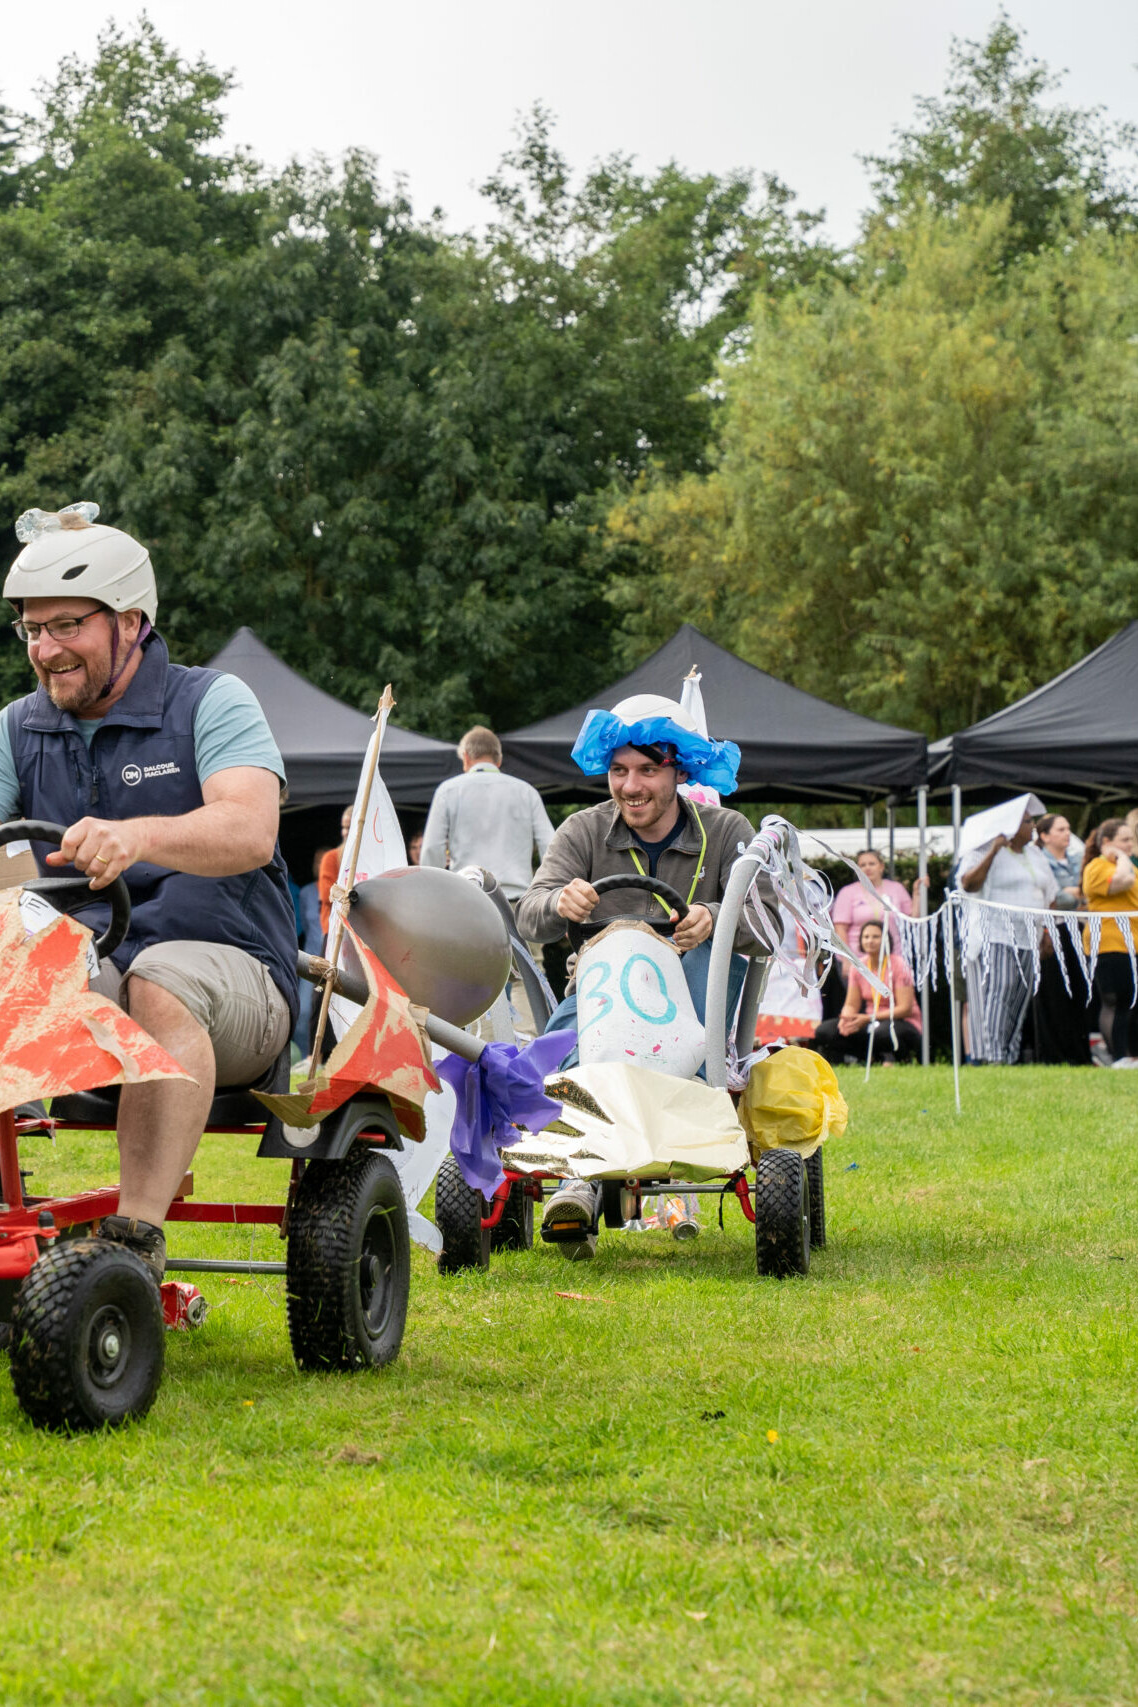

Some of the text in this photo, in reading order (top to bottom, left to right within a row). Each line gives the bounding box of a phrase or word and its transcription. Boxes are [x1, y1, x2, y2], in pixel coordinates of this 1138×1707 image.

[143, 761, 175, 772] DALCOUR
[144, 767, 181, 779] MACLAREN
[577, 953, 678, 1040] 30
